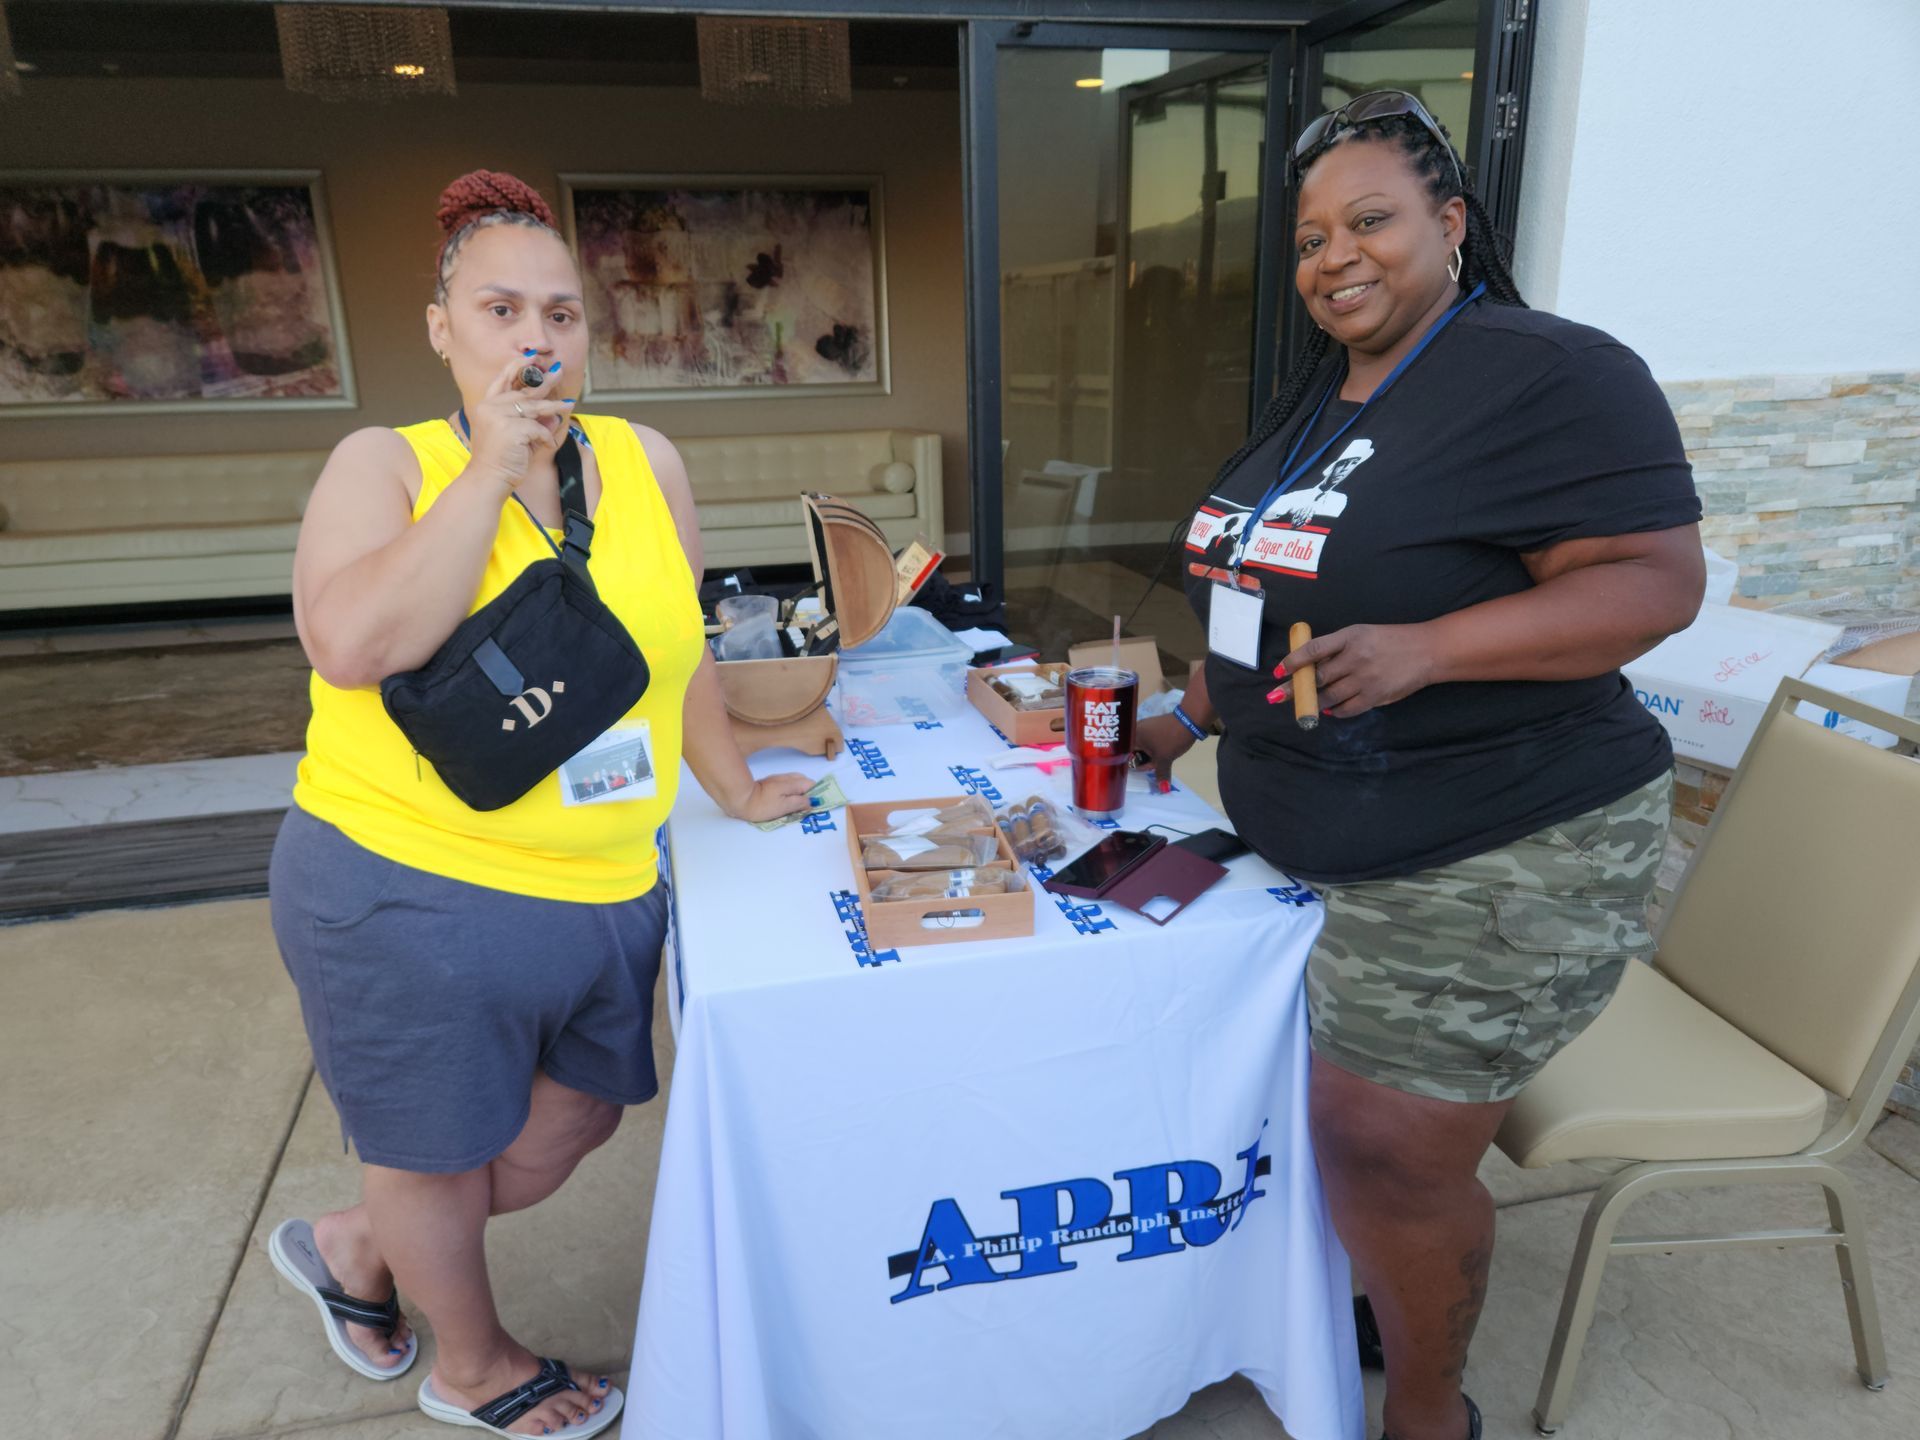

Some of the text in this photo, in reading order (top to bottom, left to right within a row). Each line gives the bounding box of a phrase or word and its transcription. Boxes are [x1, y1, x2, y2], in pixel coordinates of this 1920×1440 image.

[1254, 536, 1283, 561] Cigar
[1283, 538, 1313, 561] Club
[1084, 701, 1121, 715] FAT
[1084, 714, 1120, 727] TUES
[889, 1118, 1270, 1305] APRI
[927, 1247, 955, 1265] A.
[962, 1235, 1044, 1258] Philip
[1049, 1211, 1172, 1247] Randolph
